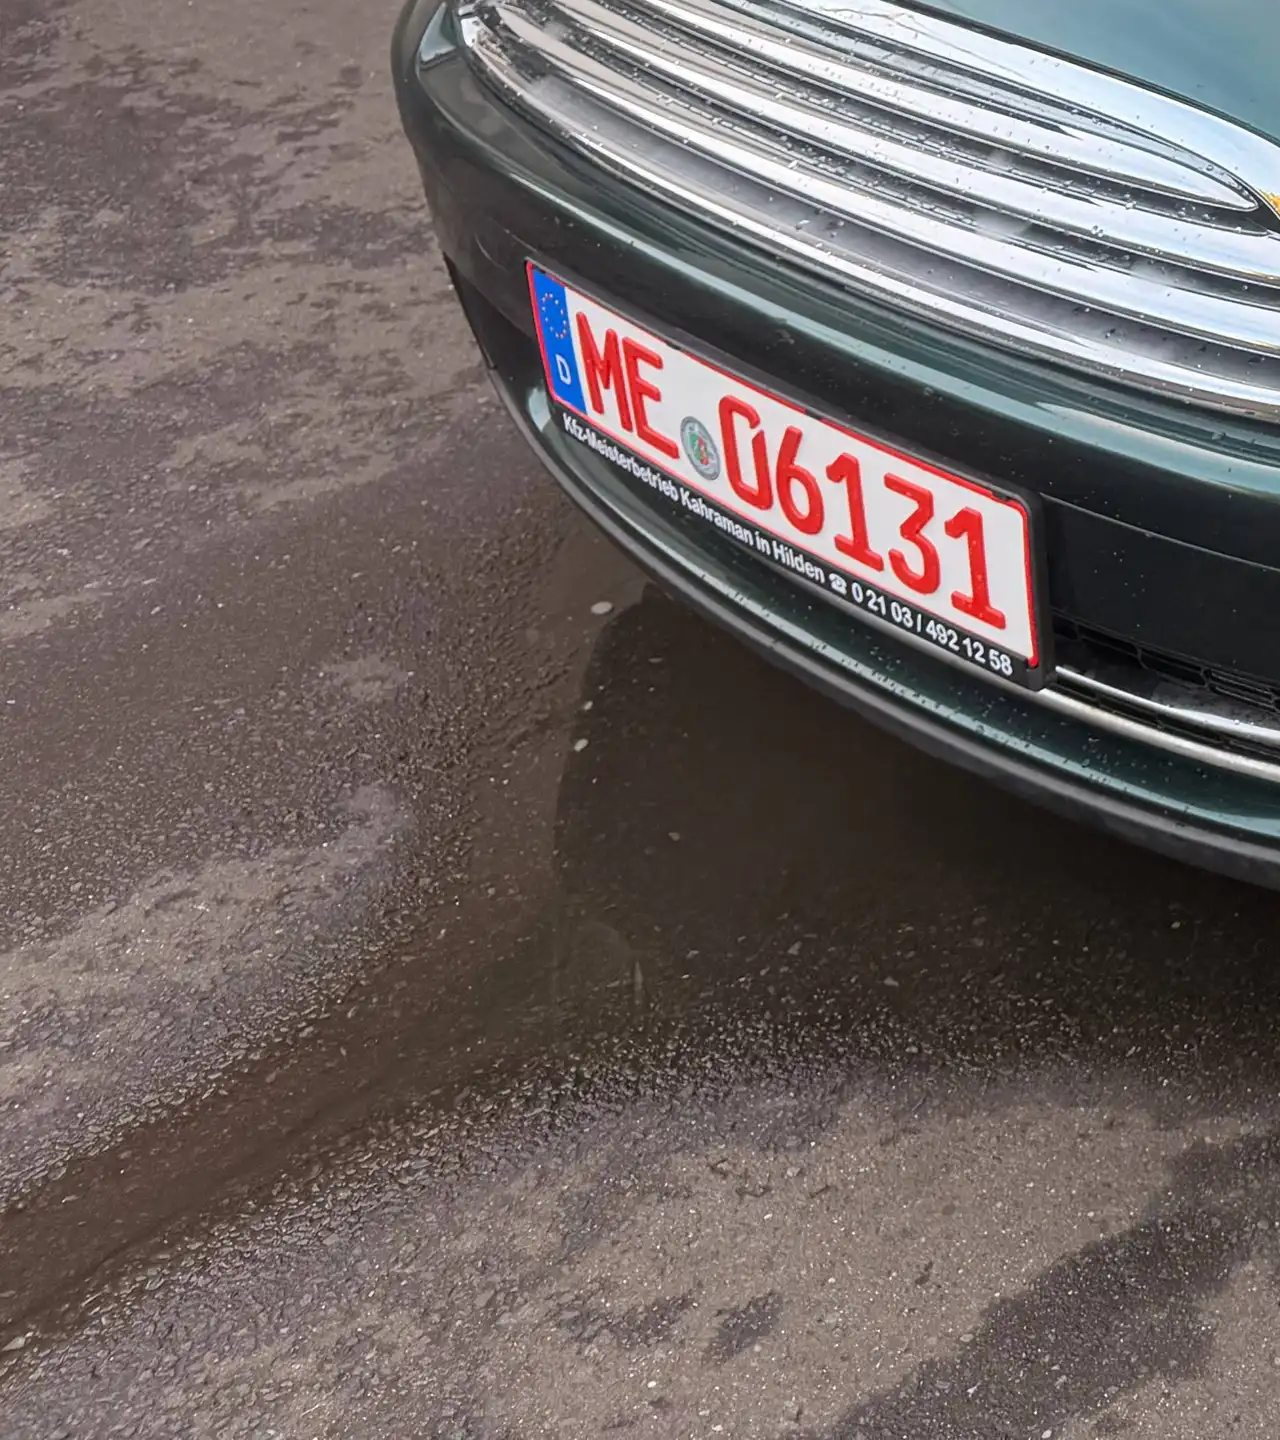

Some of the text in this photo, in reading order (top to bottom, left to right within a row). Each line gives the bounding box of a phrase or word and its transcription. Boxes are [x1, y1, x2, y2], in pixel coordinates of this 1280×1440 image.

[555, 353, 572, 385] D
[576, 312, 1006, 629] ME 06131
[563, 412, 679, 501] Kfz-Meisterbetrieb
[680, 487, 754, 546] Kahraman
[755, 531, 771, 556] in
[772, 540, 826, 584] Hilden
[851, 582, 863, 604] 0
[866, 589, 886, 616] 21
[891, 602, 914, 629] 03
[926, 620, 960, 652] 492
[962, 636, 986, 664] 12
[988, 650, 1013, 677] 58
